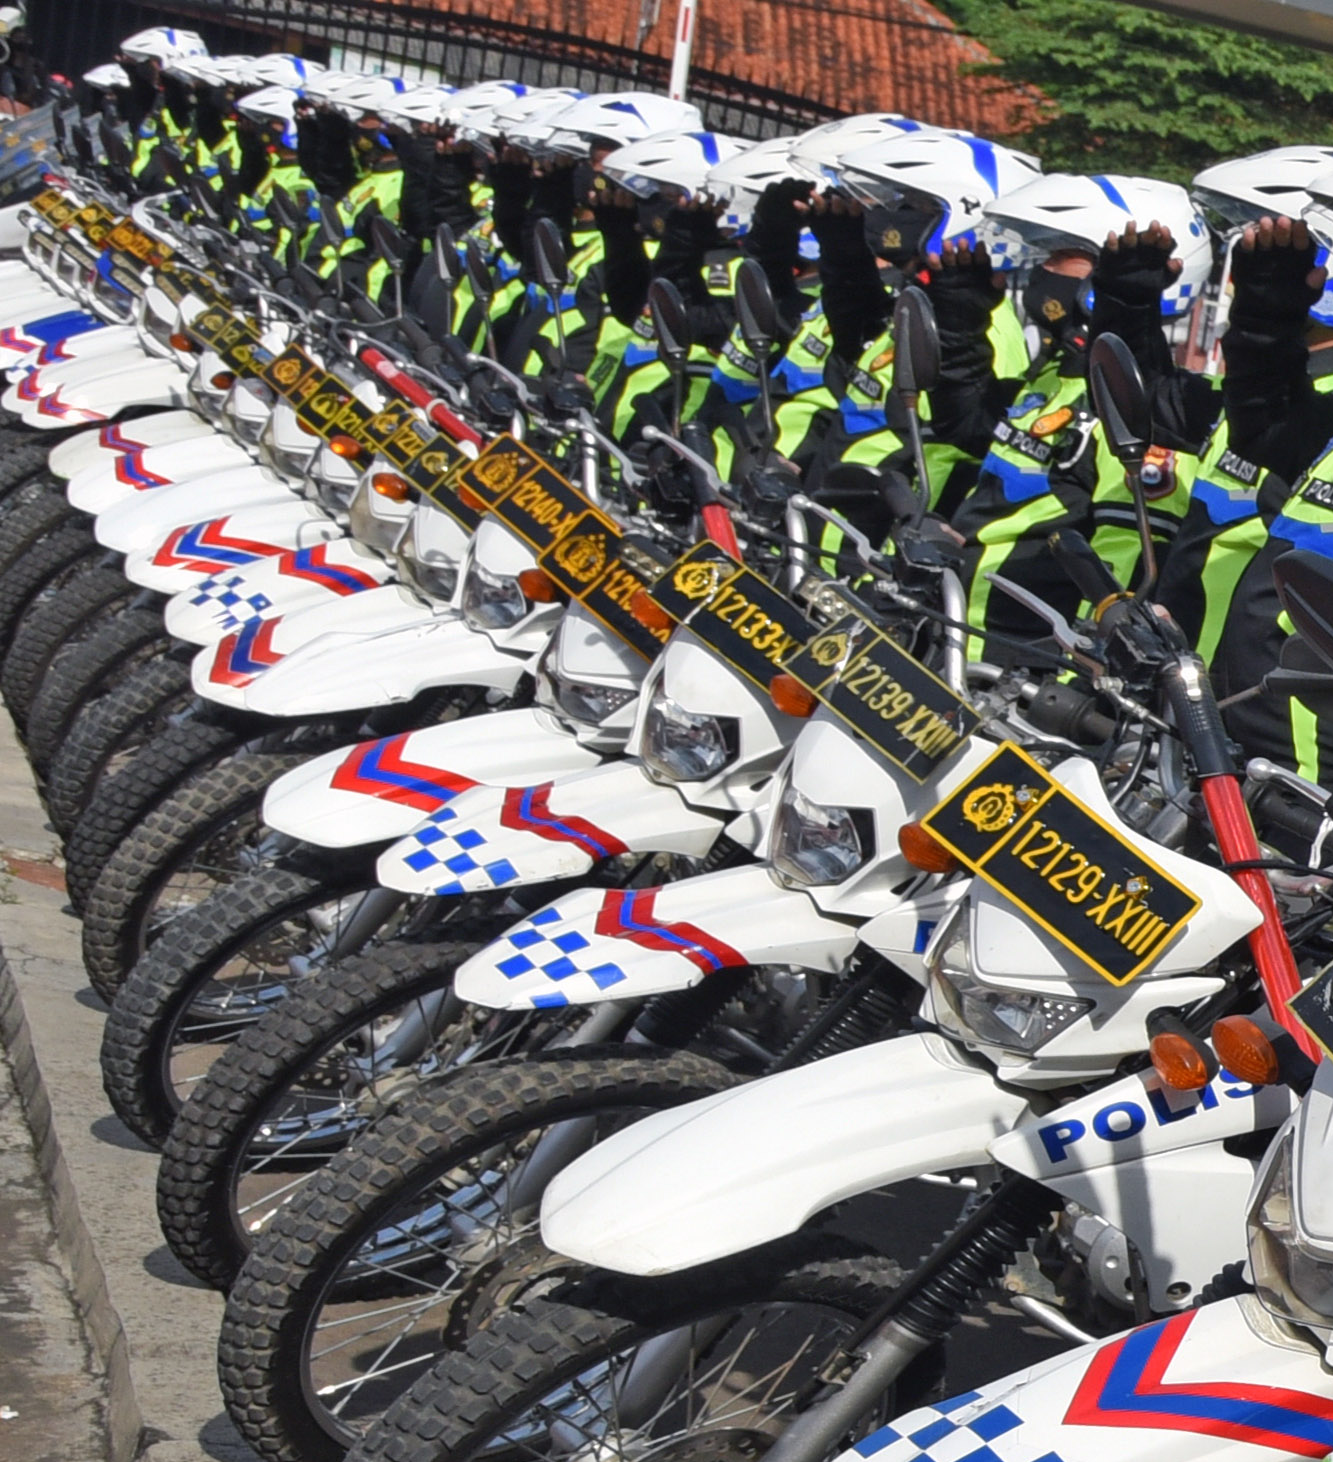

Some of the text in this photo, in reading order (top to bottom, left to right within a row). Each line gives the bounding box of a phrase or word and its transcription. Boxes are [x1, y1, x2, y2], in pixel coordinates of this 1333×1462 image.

[511, 480, 577, 540] 12140-X
[707, 585, 804, 665] 12133-X
[1011, 820, 1170, 957] 12129-XXIII
